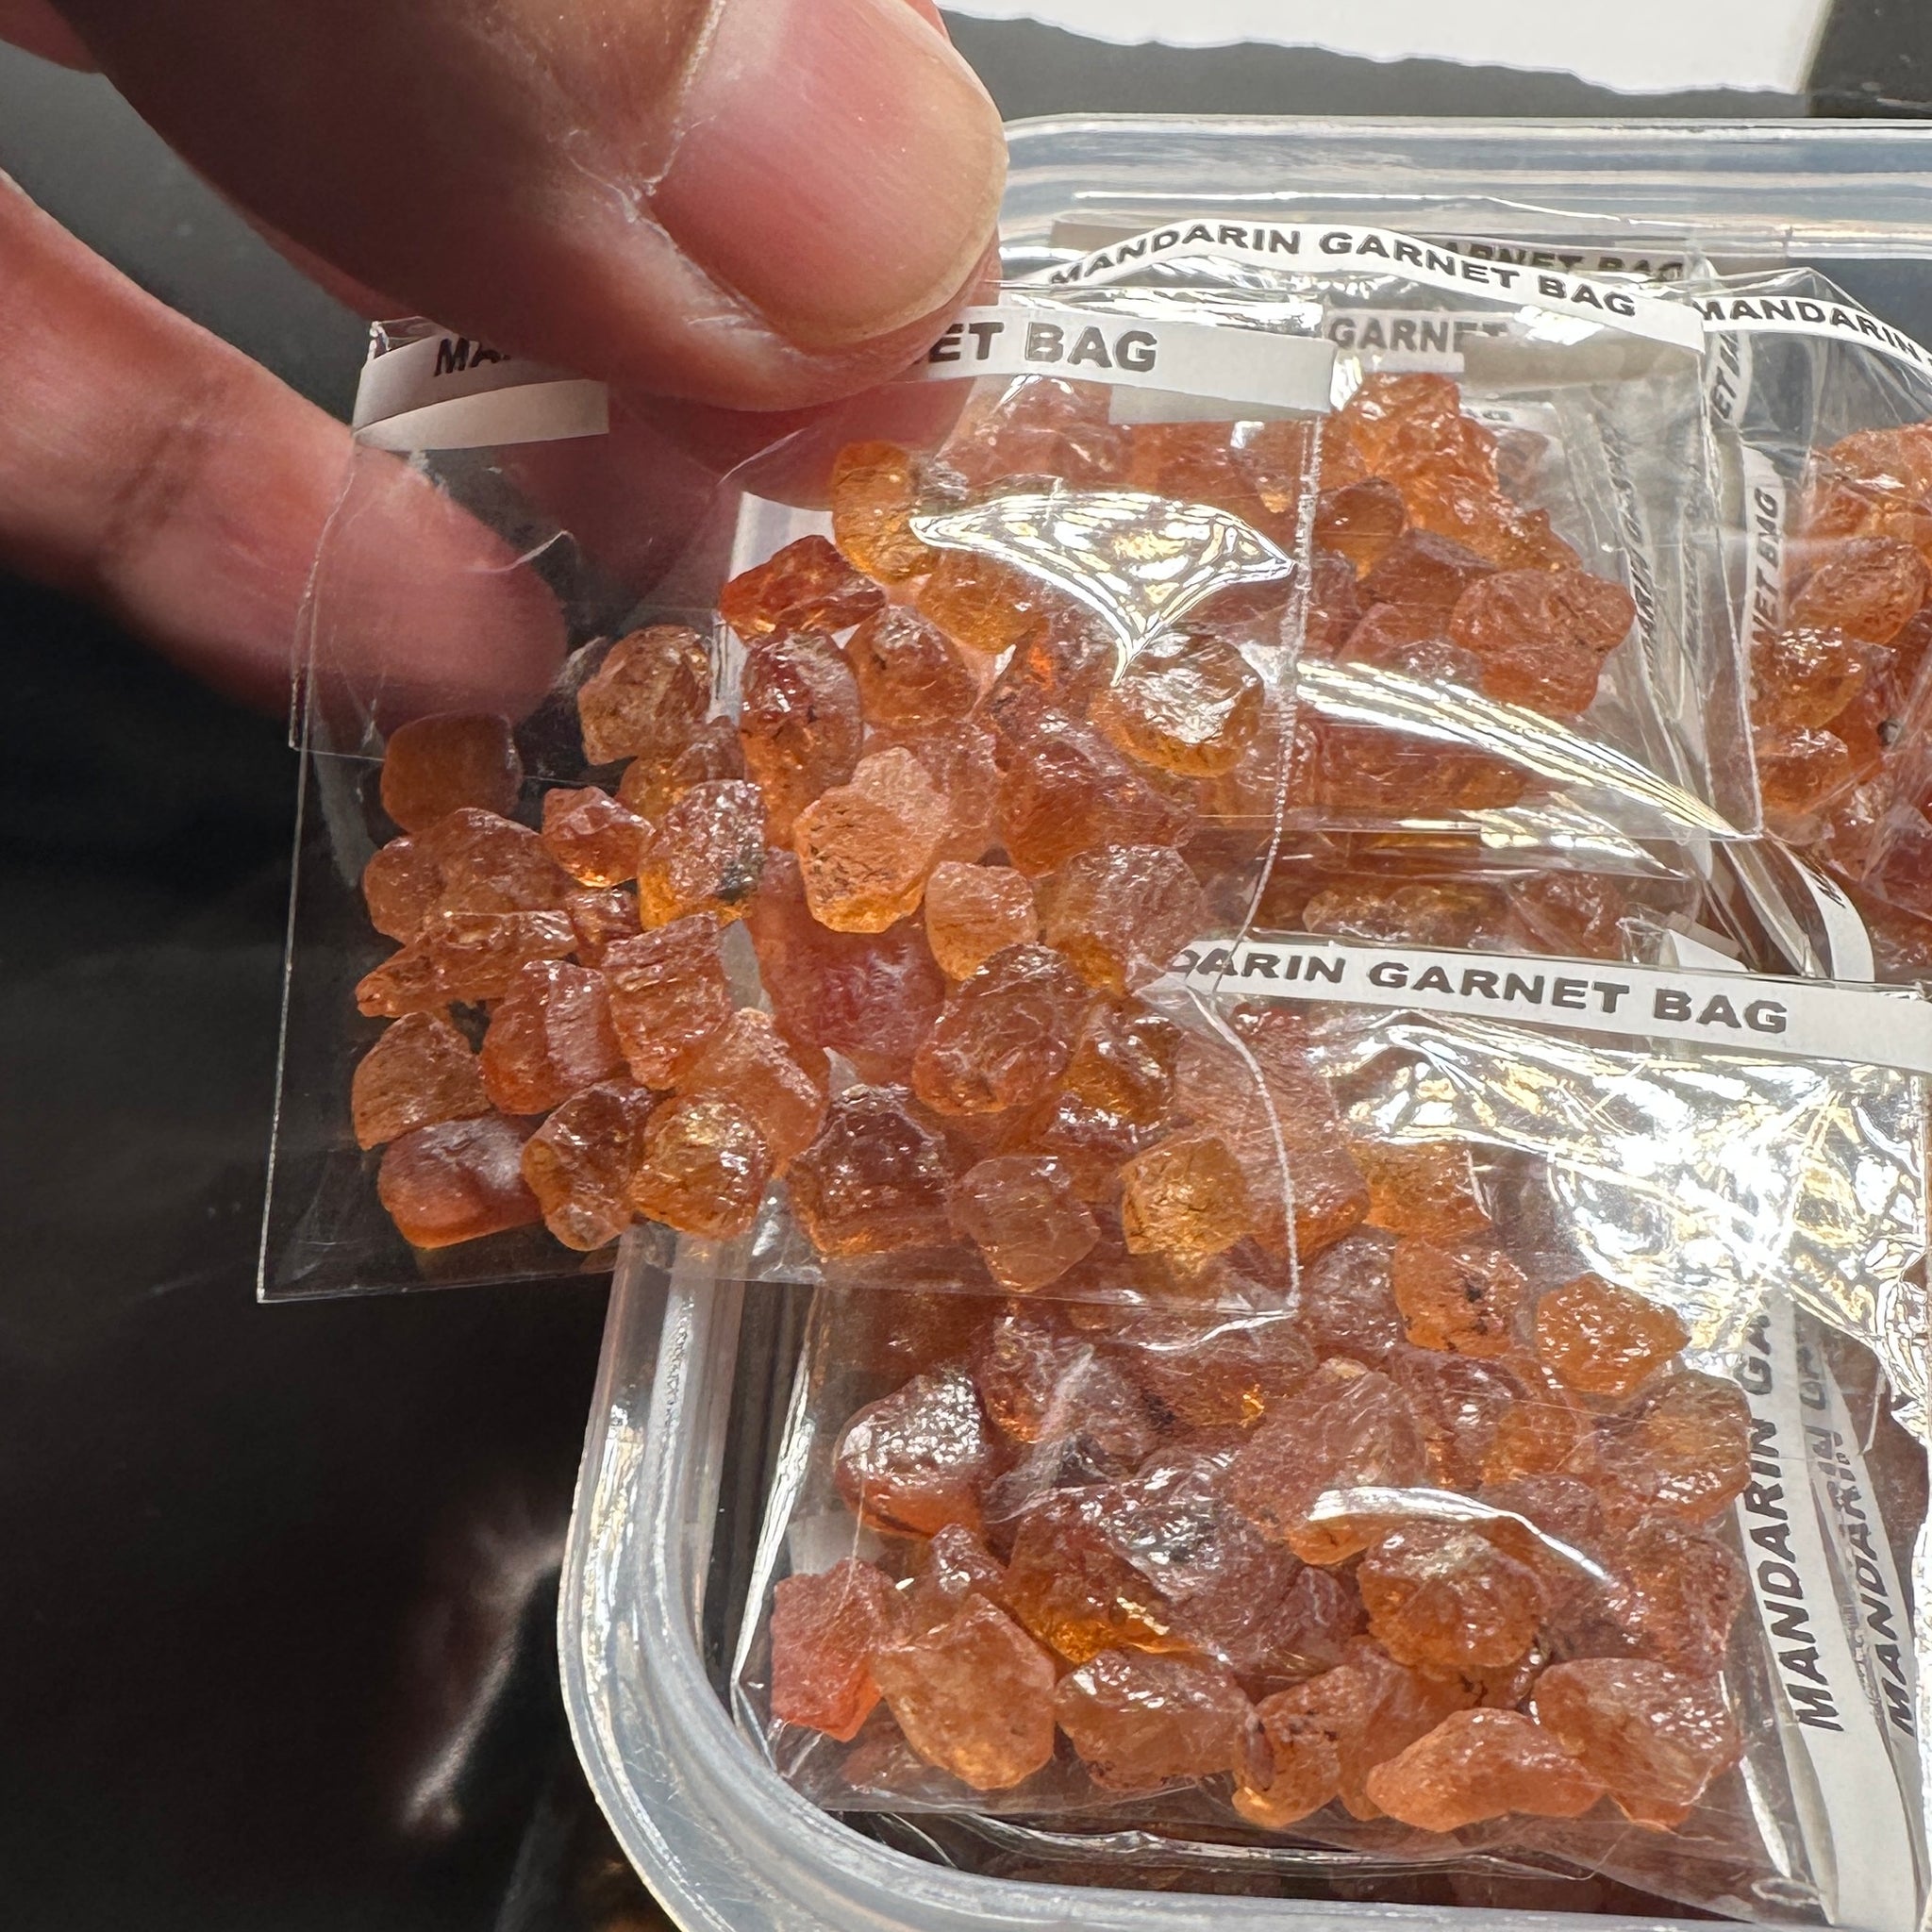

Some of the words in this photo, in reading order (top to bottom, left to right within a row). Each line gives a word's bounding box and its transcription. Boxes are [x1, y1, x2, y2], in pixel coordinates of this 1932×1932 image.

[1048, 223, 1301, 285] MANDARIN
[1320, 231, 1521, 289] GARNET
[1537, 274, 1637, 317] BAG
[1024, 321, 1158, 373] BAG
[1691, 298, 1923, 363] MANDARIN
[1367, 961, 1630, 1013] GARNET
[1654, 988, 1789, 1034] BAG
[1744, 1417, 1844, 1732] MANDARIN
